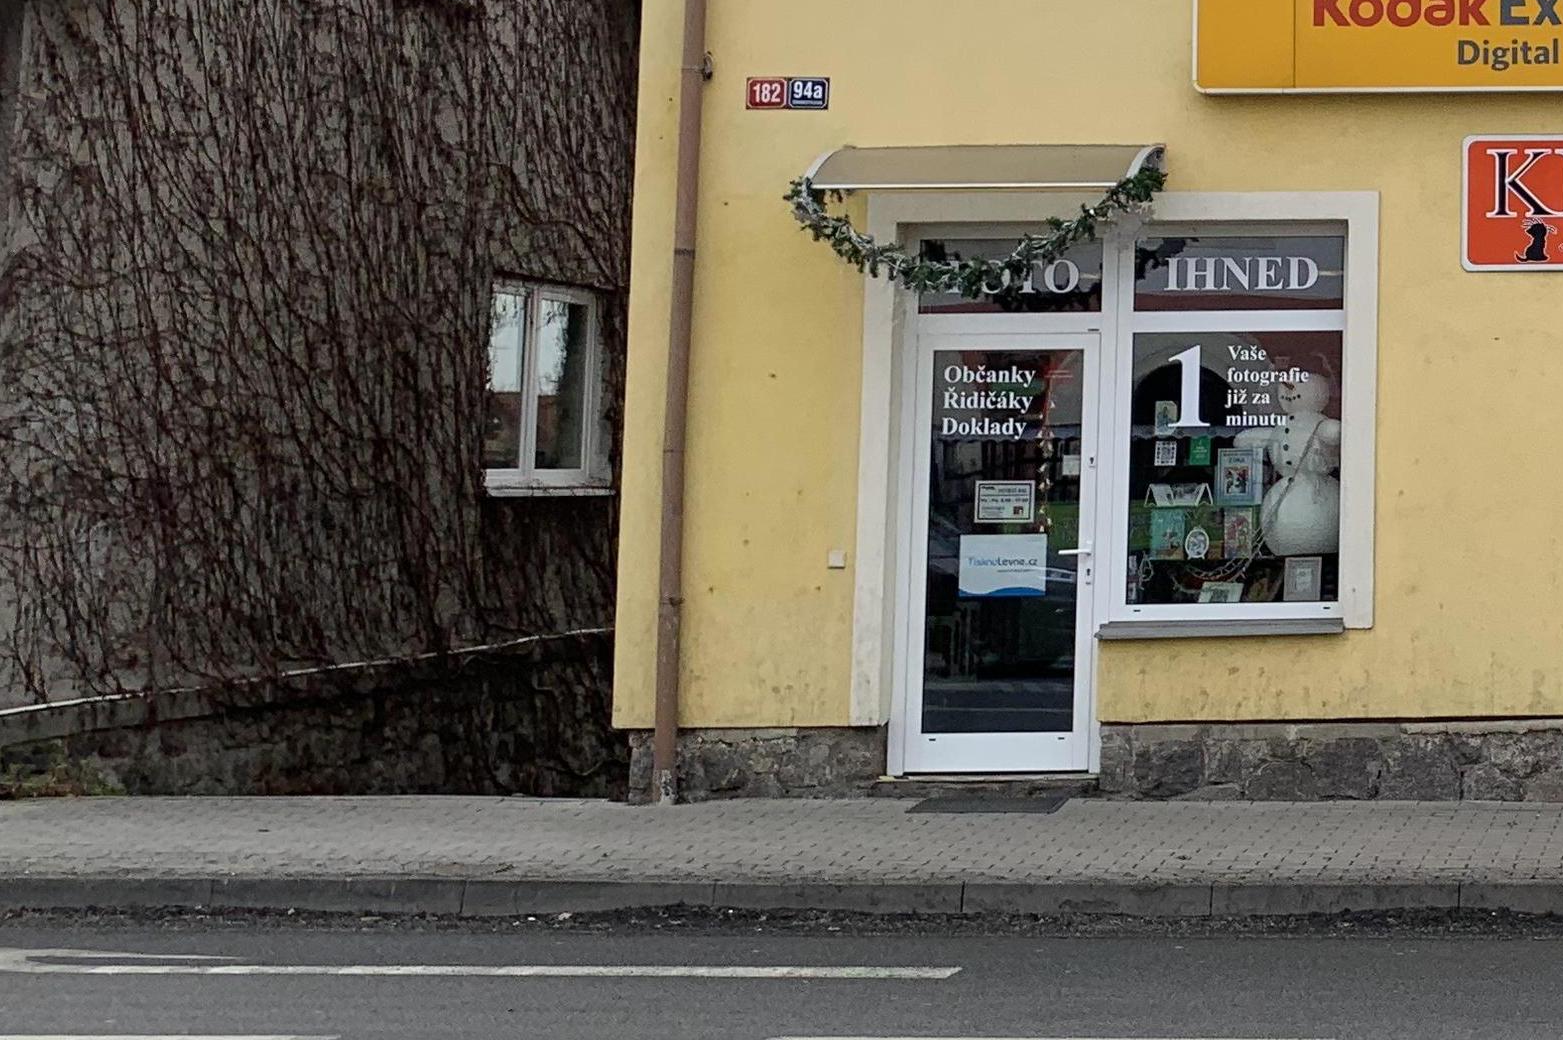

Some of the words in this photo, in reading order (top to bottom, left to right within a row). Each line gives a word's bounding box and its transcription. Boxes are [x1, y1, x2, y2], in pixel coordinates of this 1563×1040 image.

[1457, 38, 1559, 71] Digital
[752, 83, 781, 103] 182
[793, 80, 823, 99] 94a
[1164, 256, 1320, 292] IHNED
[1227, 345, 1267, 361] Vaše
[944, 364, 1037, 388] Občanky
[1168, 344, 1211, 427] 1
[1226, 367, 1310, 385] fotografie
[943, 387, 1034, 414] Řidičáky
[1224, 389, 1248, 408] již
[1251, 392, 1271, 405] za
[941, 417, 1028, 440] Doklady
[1226, 412, 1288, 427] minutu
